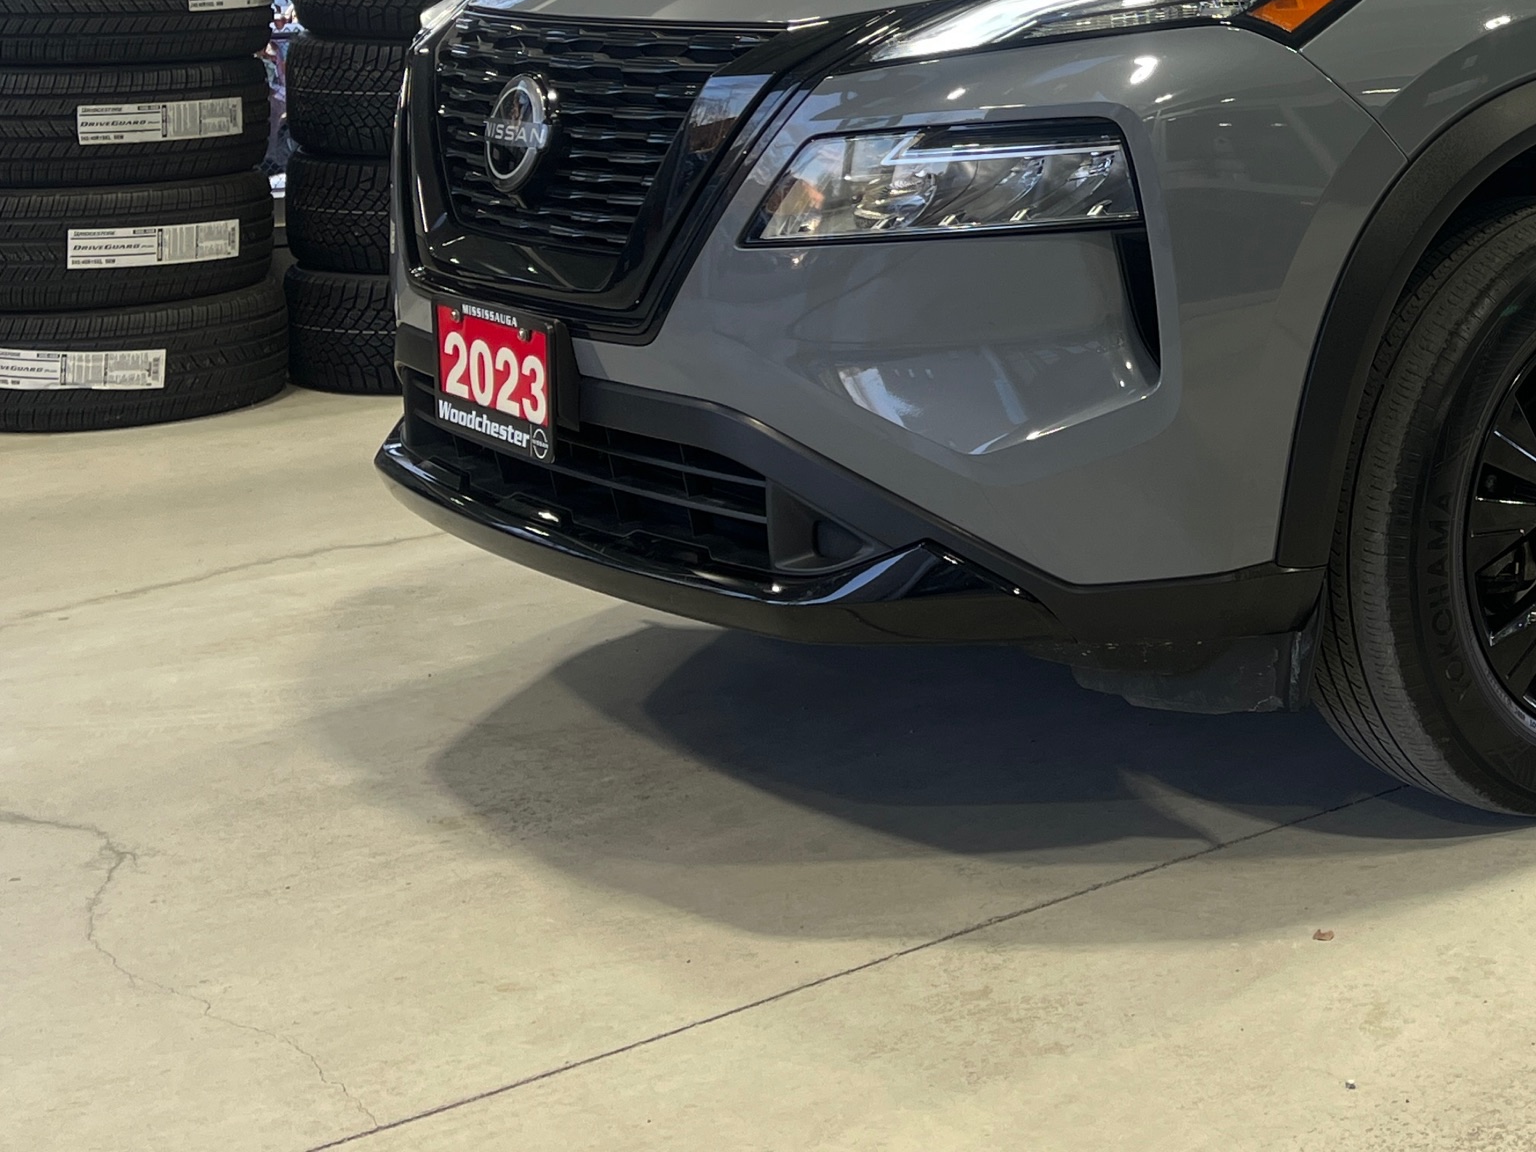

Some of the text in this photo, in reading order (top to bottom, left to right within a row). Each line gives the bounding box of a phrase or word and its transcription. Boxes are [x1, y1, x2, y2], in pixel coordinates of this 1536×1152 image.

[483, 120, 545, 144] NISSAN
[462, 303, 518, 328] MISSISSAUGA
[444, 331, 547, 426] 2023
[438, 399, 530, 448] Woodchester
